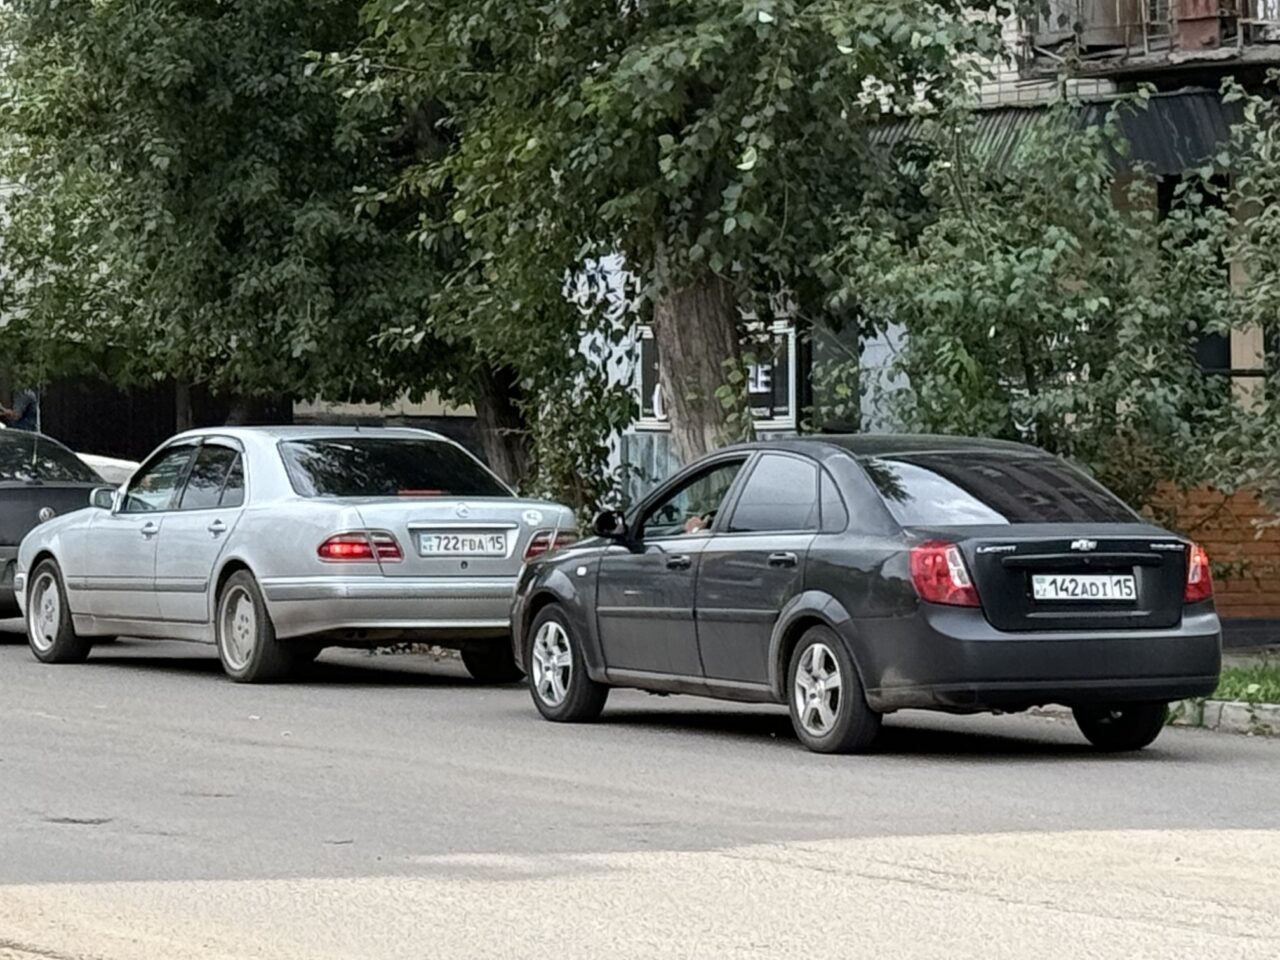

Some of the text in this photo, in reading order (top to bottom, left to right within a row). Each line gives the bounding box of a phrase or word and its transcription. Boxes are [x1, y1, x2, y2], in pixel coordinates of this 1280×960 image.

[433, 535, 485, 551] 722FDA
[487, 535, 504, 551] 15
[1048, 577, 1133, 597] 142ADI 15
